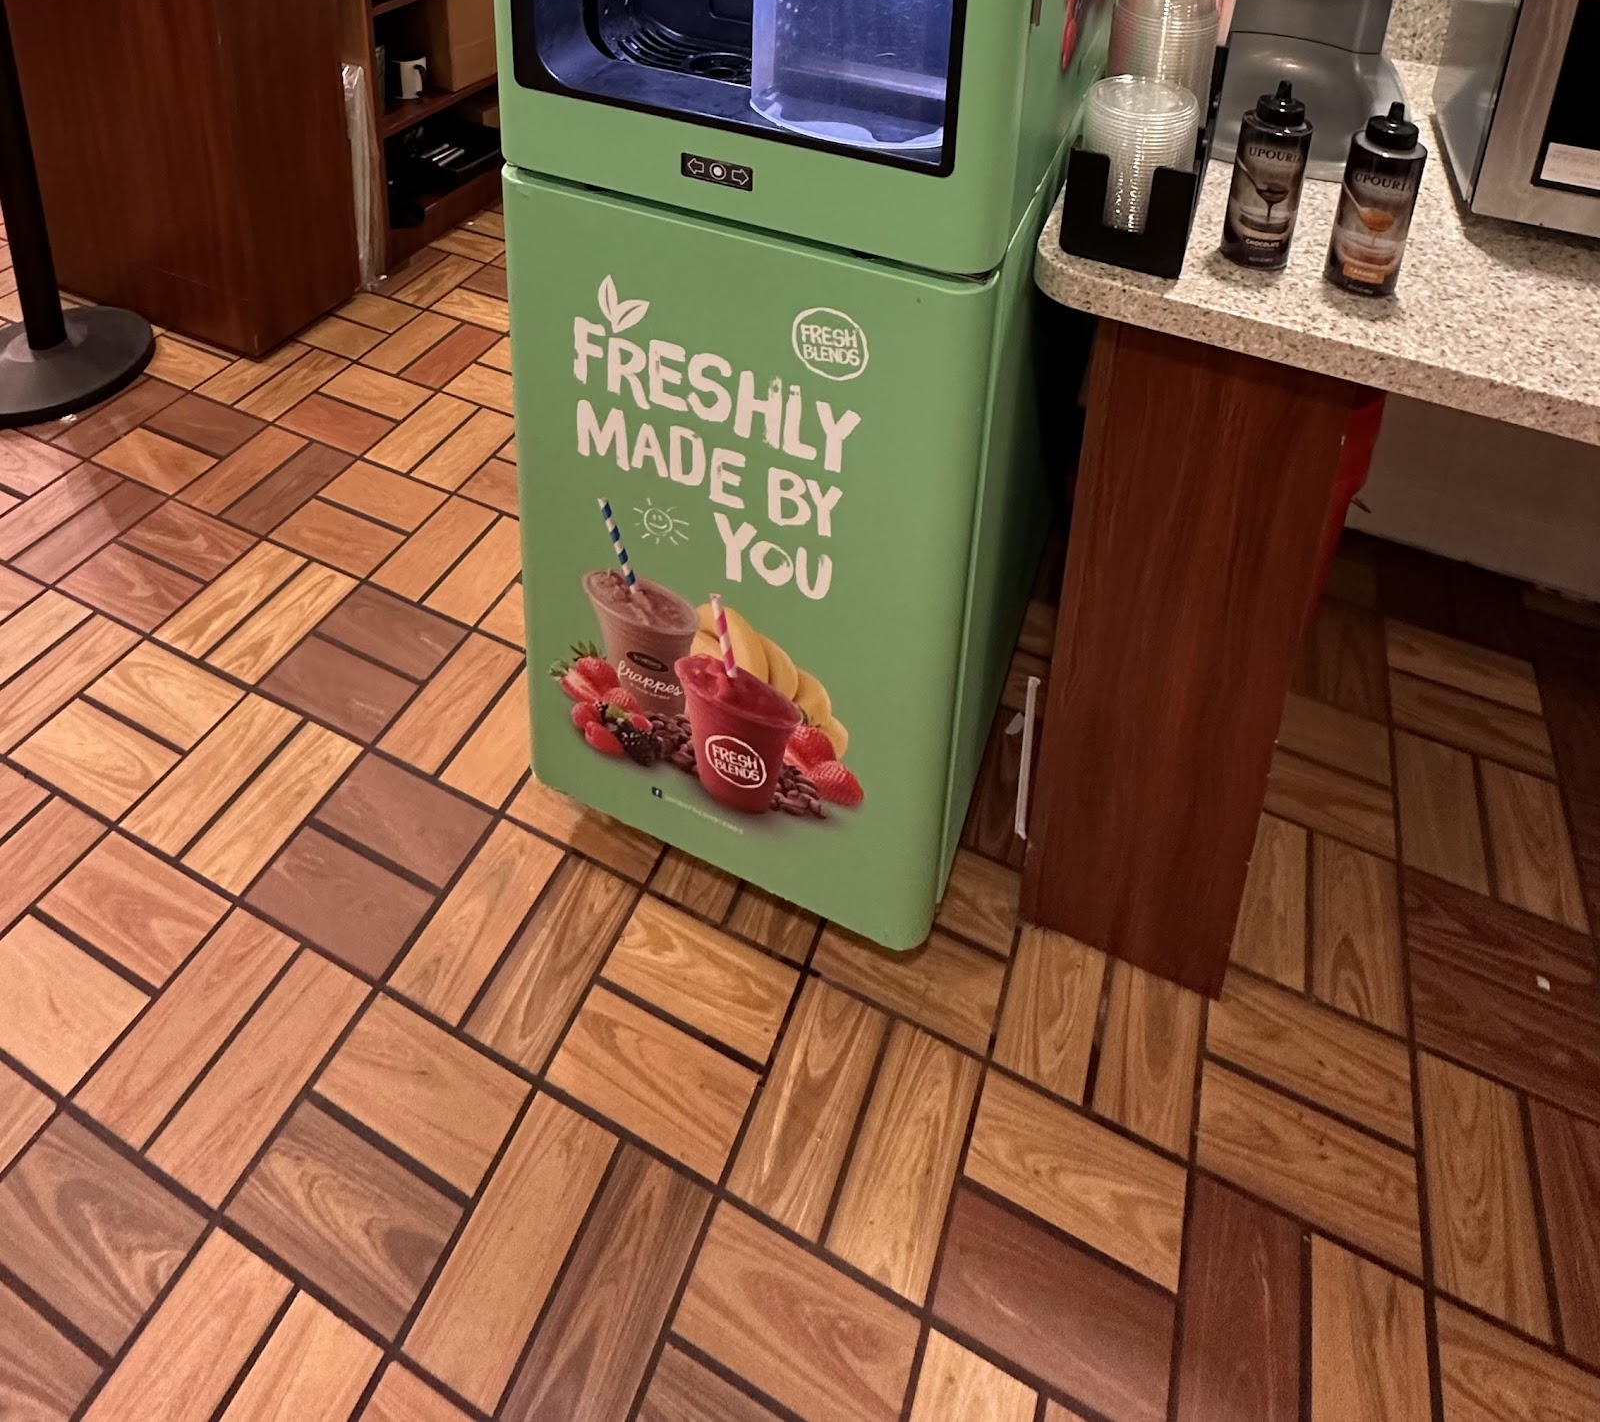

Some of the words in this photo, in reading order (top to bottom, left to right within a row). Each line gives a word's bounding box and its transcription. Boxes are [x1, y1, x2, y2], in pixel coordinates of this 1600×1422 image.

[800, 323, 858, 348] FRESH
[802, 343, 860, 366] BLENDS
[572, 316, 862, 473] FRESHLY
[576, 399, 746, 509] MADE
[768, 466, 843, 538] BY
[713, 511, 833, 600] YOU
[711, 743, 758, 770] FRESH
[714, 758, 760, 781] BLENDS
